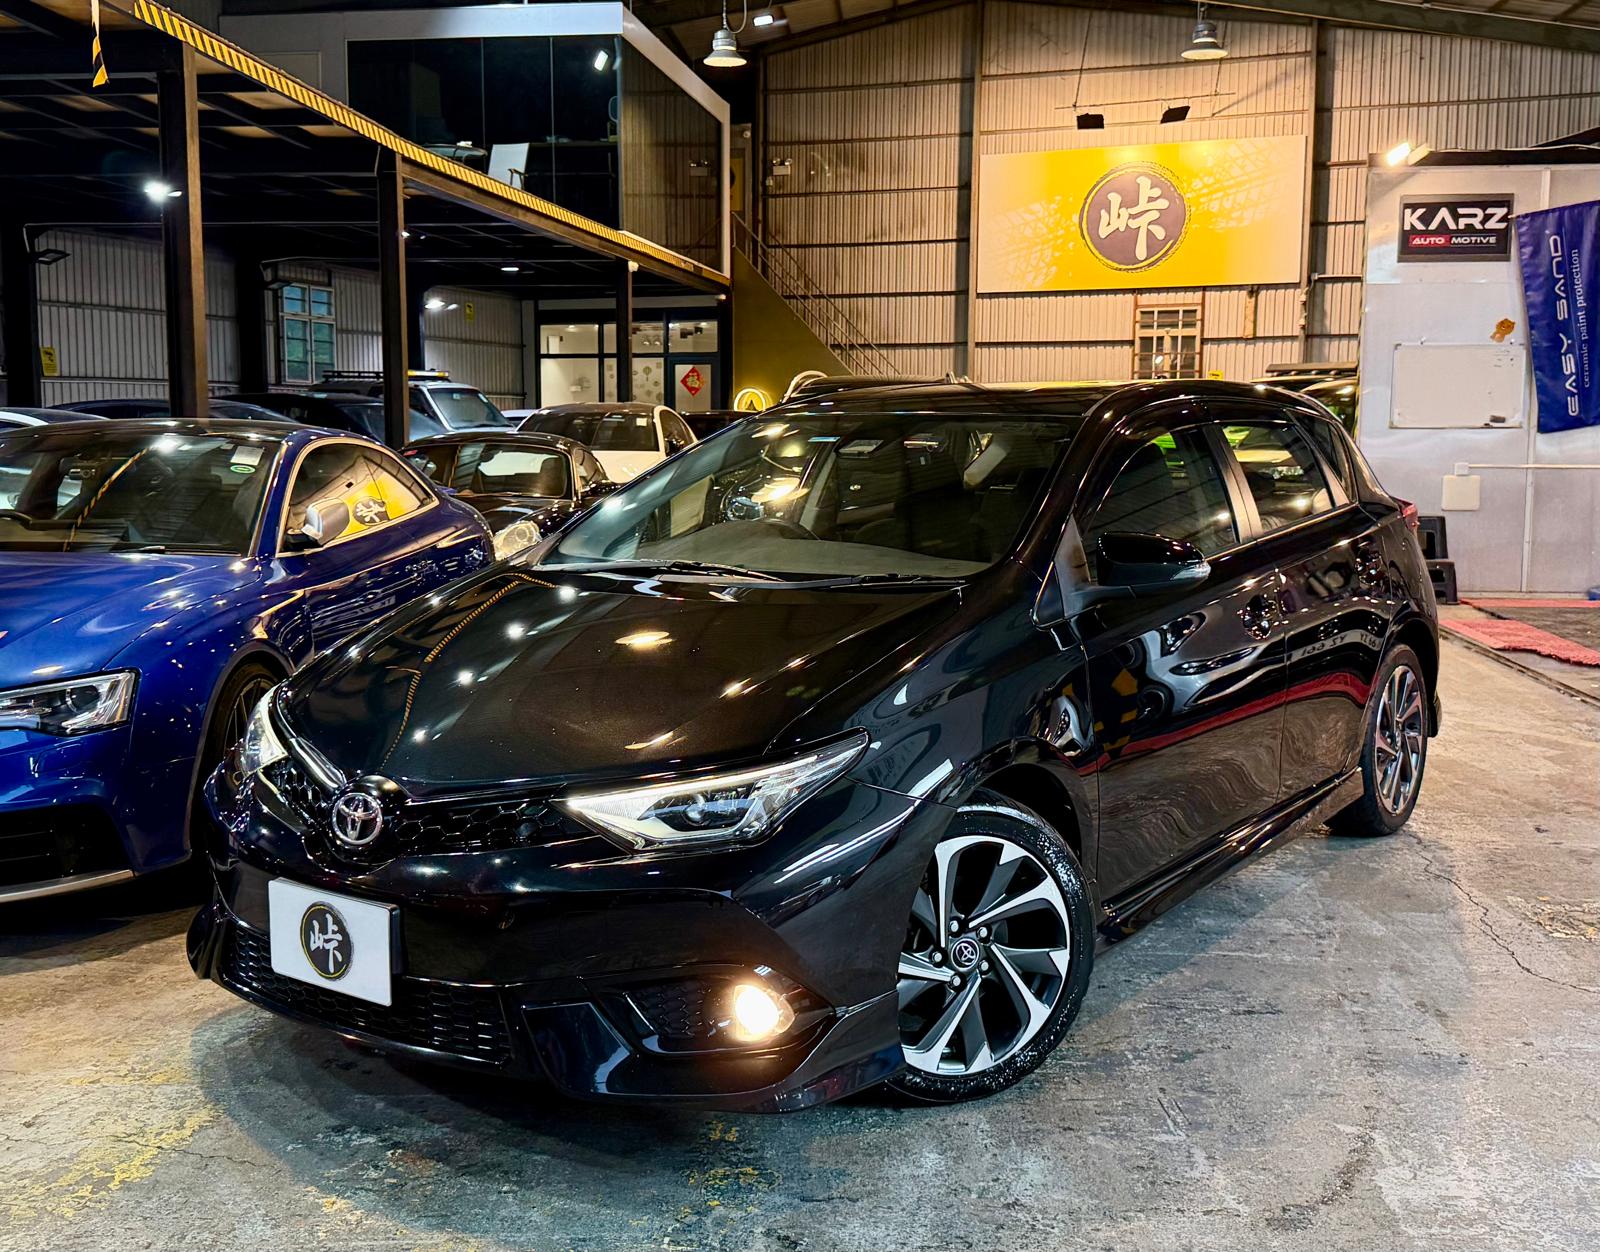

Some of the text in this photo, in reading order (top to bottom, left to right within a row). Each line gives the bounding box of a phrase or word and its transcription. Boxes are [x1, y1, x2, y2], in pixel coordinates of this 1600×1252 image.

[1098, 175, 1170, 261] 峠
[1403, 206, 1509, 231] KARZ
[1412, 236, 1497, 245] AUTO MOTIVE
[1549, 234, 1580, 417] EASY SAND
[1571, 248, 1590, 388] ceramic paint protection
[309, 912, 343, 974] 峠
